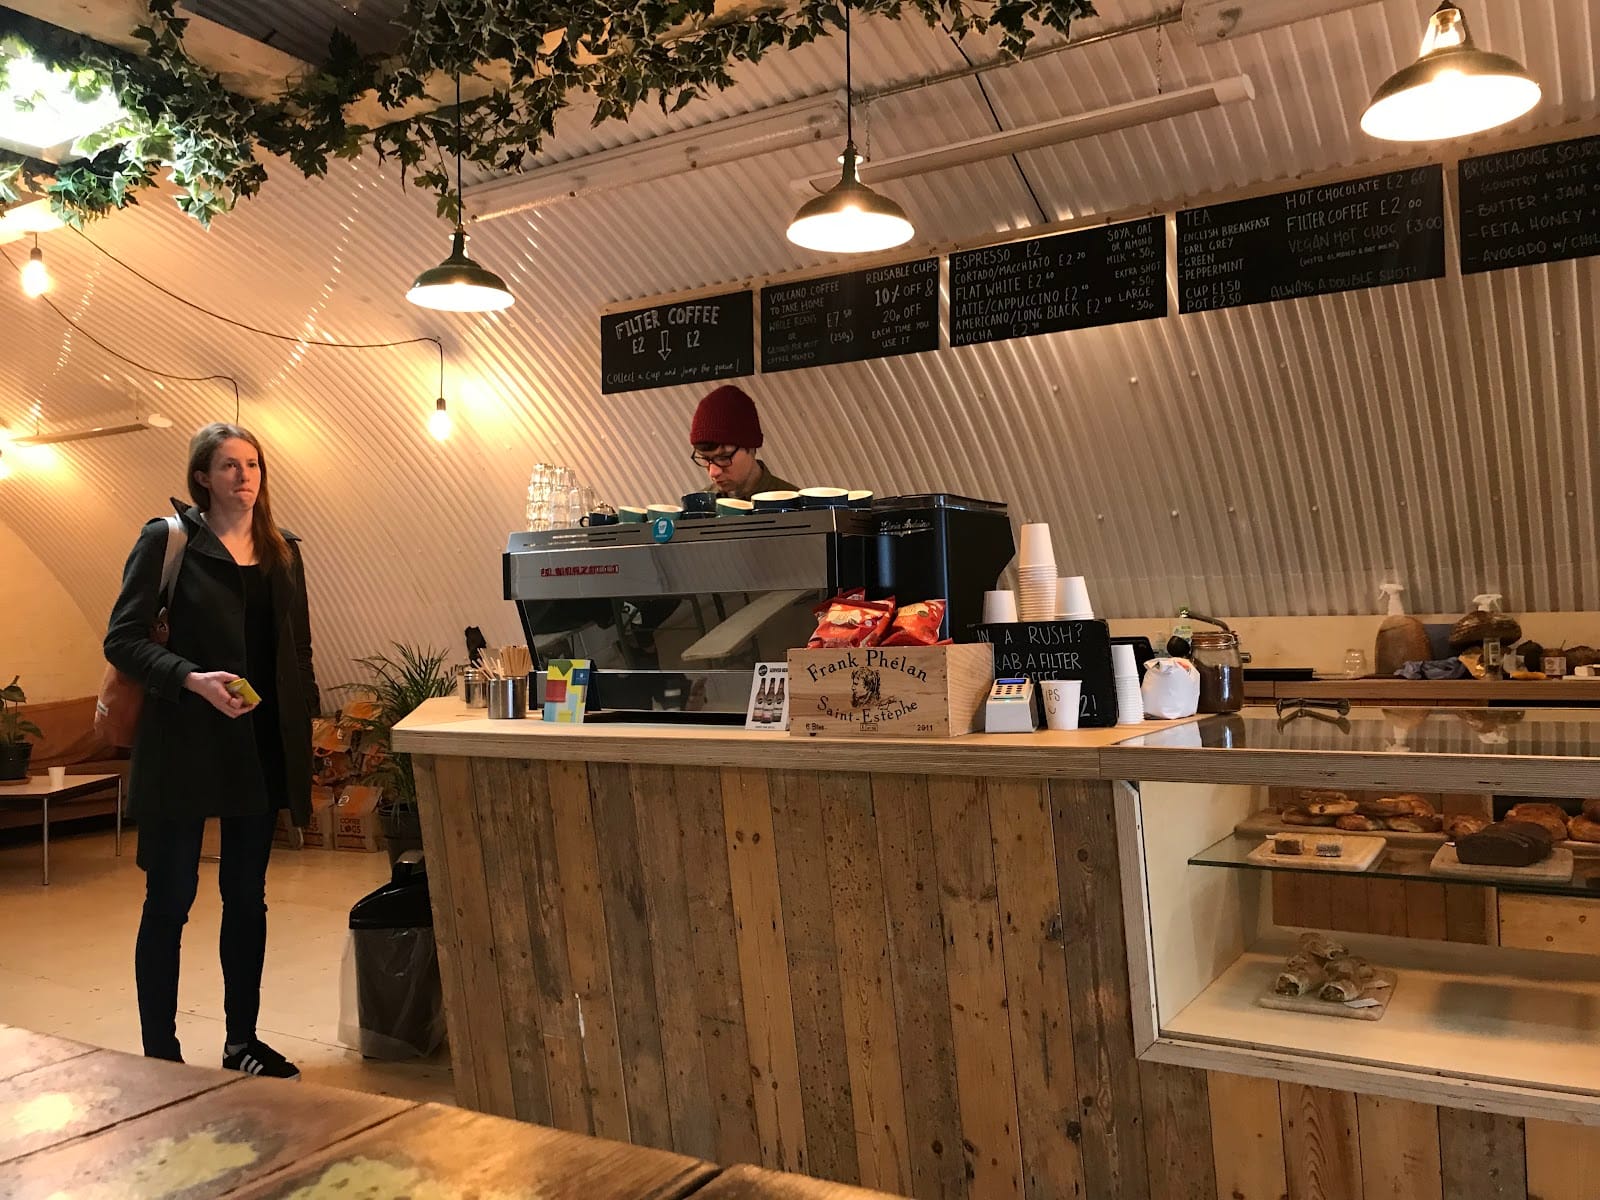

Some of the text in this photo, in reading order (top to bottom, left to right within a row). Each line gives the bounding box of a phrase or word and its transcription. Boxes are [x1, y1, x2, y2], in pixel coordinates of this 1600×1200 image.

[1285, 189, 1314, 211] HOT
[1316, 179, 1381, 202] CHOCOLATE
[1478, 195, 1537, 216] BUTTER
[1183, 208, 1212, 227] TEA
[1221, 216, 1271, 237] BREAKFAST
[1286, 210, 1326, 233] FILTER
[1327, 201, 1369, 225] COFFEE
[1530, 209, 1581, 231] HONEY
[1136, 222, 1153, 236] OAT
[1288, 231, 1330, 254] VEGAN
[1334, 227, 1356, 248] HOT
[1363, 223, 1397, 240] CHOC
[1111, 235, 1153, 253] OR ALMOND
[1209, 236, 1234, 251] GREY
[1483, 240, 1547, 261] AVOCADO
[955, 248, 1010, 271] ESPRESSO
[1106, 253, 1127, 265] MILK
[1114, 260, 1161, 279] EXTRA SHOT
[1185, 257, 1245, 281] PEPPERMINT
[865, 260, 938, 285] REUSABLE CUPS
[769, 280, 840, 305] VOLCANO COFFEE
[874, 278, 934, 307] 10% OFF &
[955, 283, 981, 301] FLAT
[985, 276, 1021, 297] WHITE
[1118, 286, 1151, 302] LARGE
[1185, 284, 1209, 300] CUP
[1270, 279, 1314, 299] ALWAYS
[769, 297, 825, 315] TO TAKE HOME
[883, 302, 922, 323] 20p OFF
[1047, 302, 1080, 320] BLACK
[1186, 297, 1209, 313] POT
[615, 305, 721, 340] FILTER COFFEE
[871, 320, 930, 340] EACH TIME YOU
[881, 335, 910, 349] USE IT
[955, 329, 993, 345] MOCHA
[977, 622, 1083, 646] IN A RUSH?
[807, 649, 928, 683] Frank Phélan
[1025, 653, 1037, 669] A
[1039, 652, 1082, 670] FILTER
[817, 695, 918, 723] Saint-Estèphe
